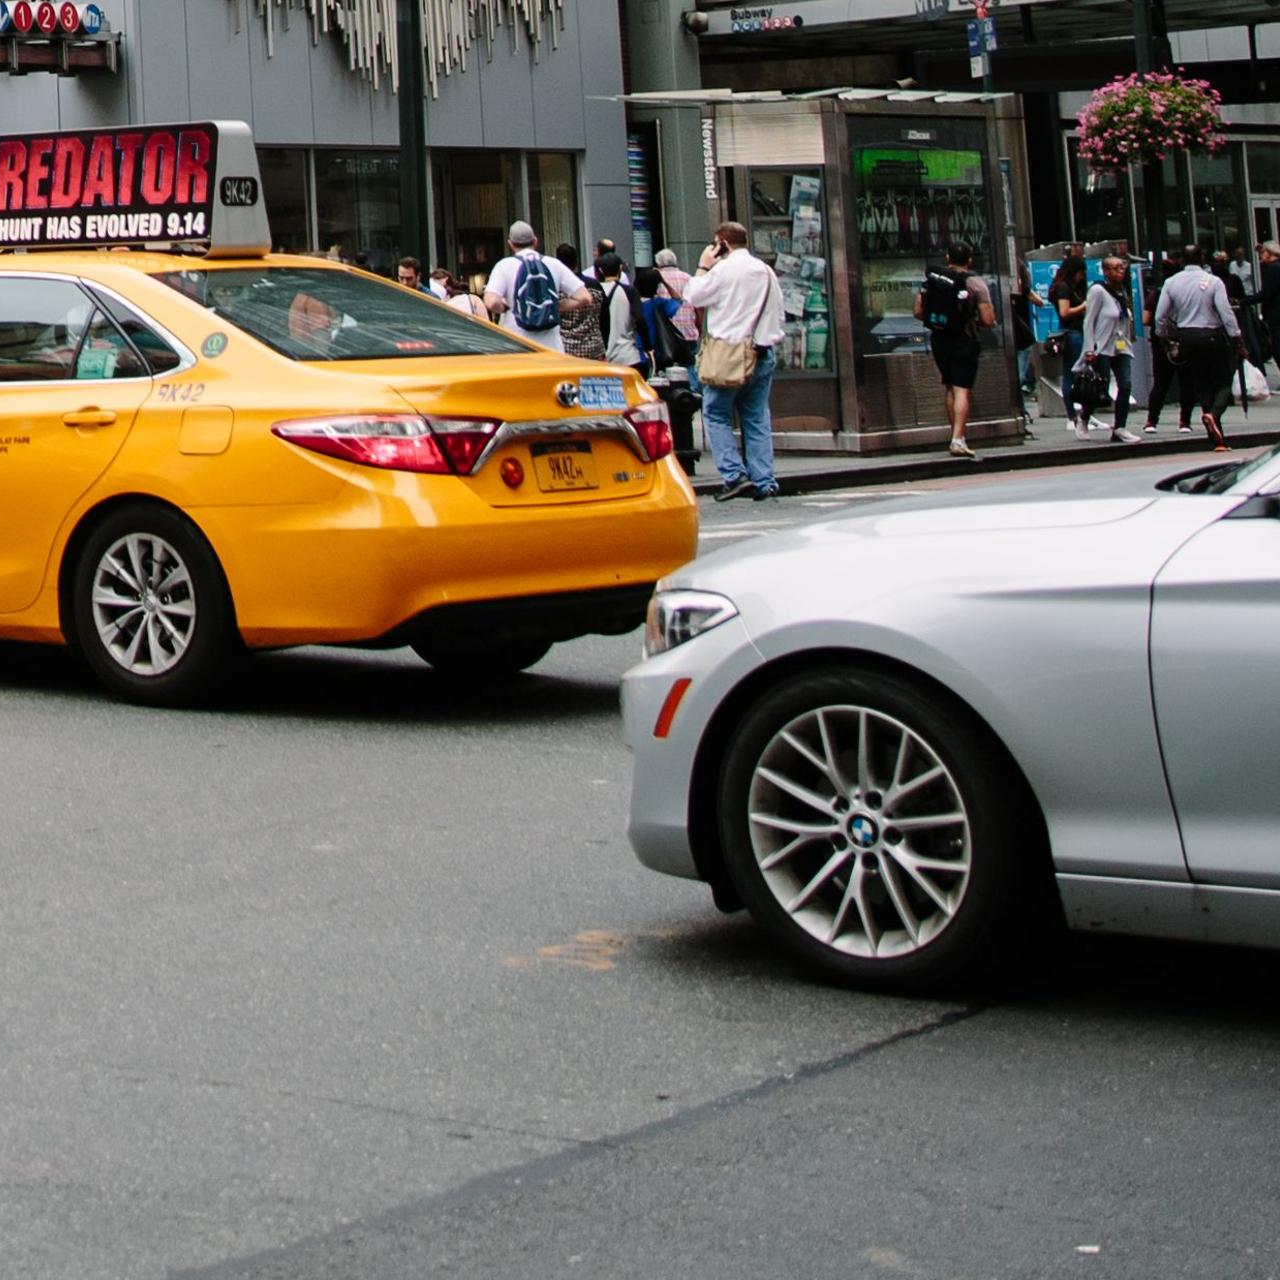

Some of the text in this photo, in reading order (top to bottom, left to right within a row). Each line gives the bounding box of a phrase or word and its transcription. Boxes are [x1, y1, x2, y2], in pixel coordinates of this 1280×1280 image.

[18, 7, 28, 27] 1
[41, 7, 52, 29] 2
[63, 6, 74, 27] 3
[731, 8, 773, 20] Subway
[701, 118, 718, 199] Newsstand
[224, 180, 253, 205] 9K42
[46, 215, 81, 240] HAS
[86, 213, 163, 239] EVOLVED
[167, 212, 206, 236] 9.14
[156, 383, 206, 404] 9K42
